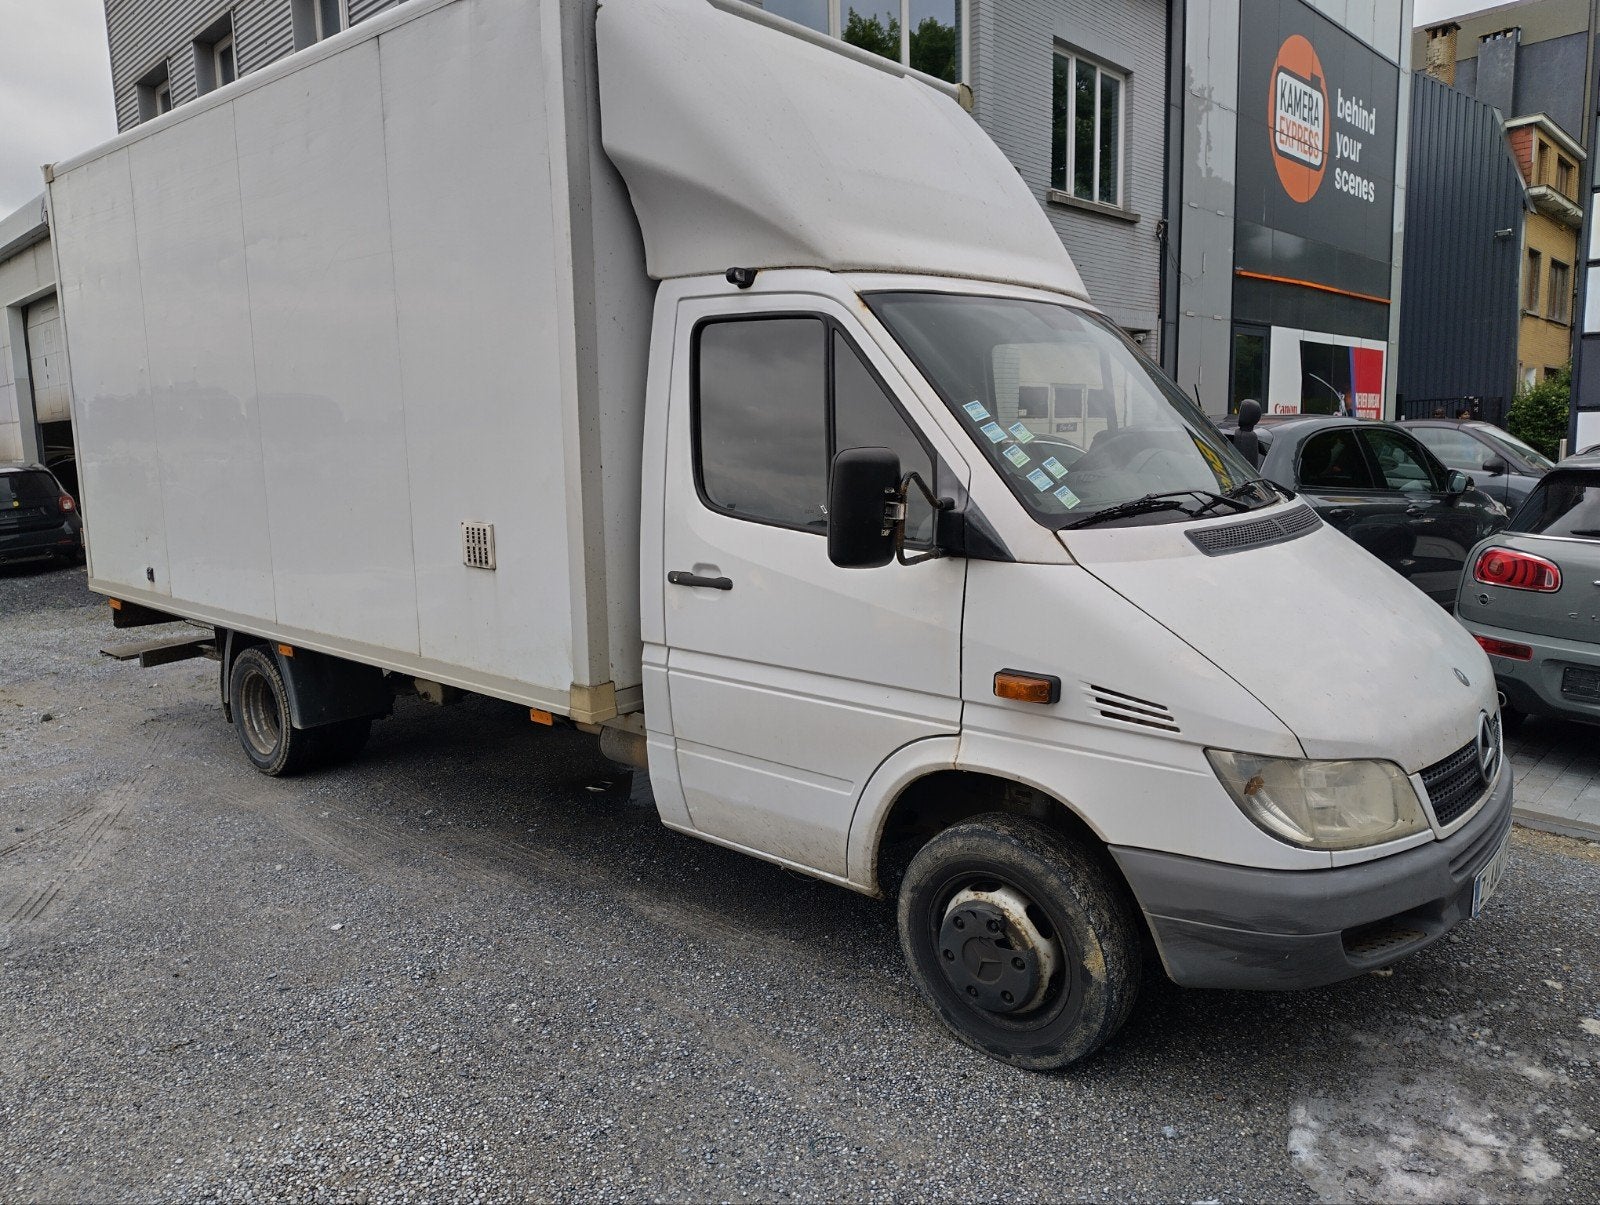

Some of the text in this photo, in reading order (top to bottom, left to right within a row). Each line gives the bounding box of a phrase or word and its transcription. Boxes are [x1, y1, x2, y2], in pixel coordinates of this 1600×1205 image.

[1279, 79, 1320, 129] KAMERA
[1336, 88, 1376, 136] behind
[1278, 115, 1320, 159] EXPRESS
[1335, 131, 1363, 163] your
[1334, 167, 1376, 203] scenes
[1274, 403, 1298, 415] Canon
